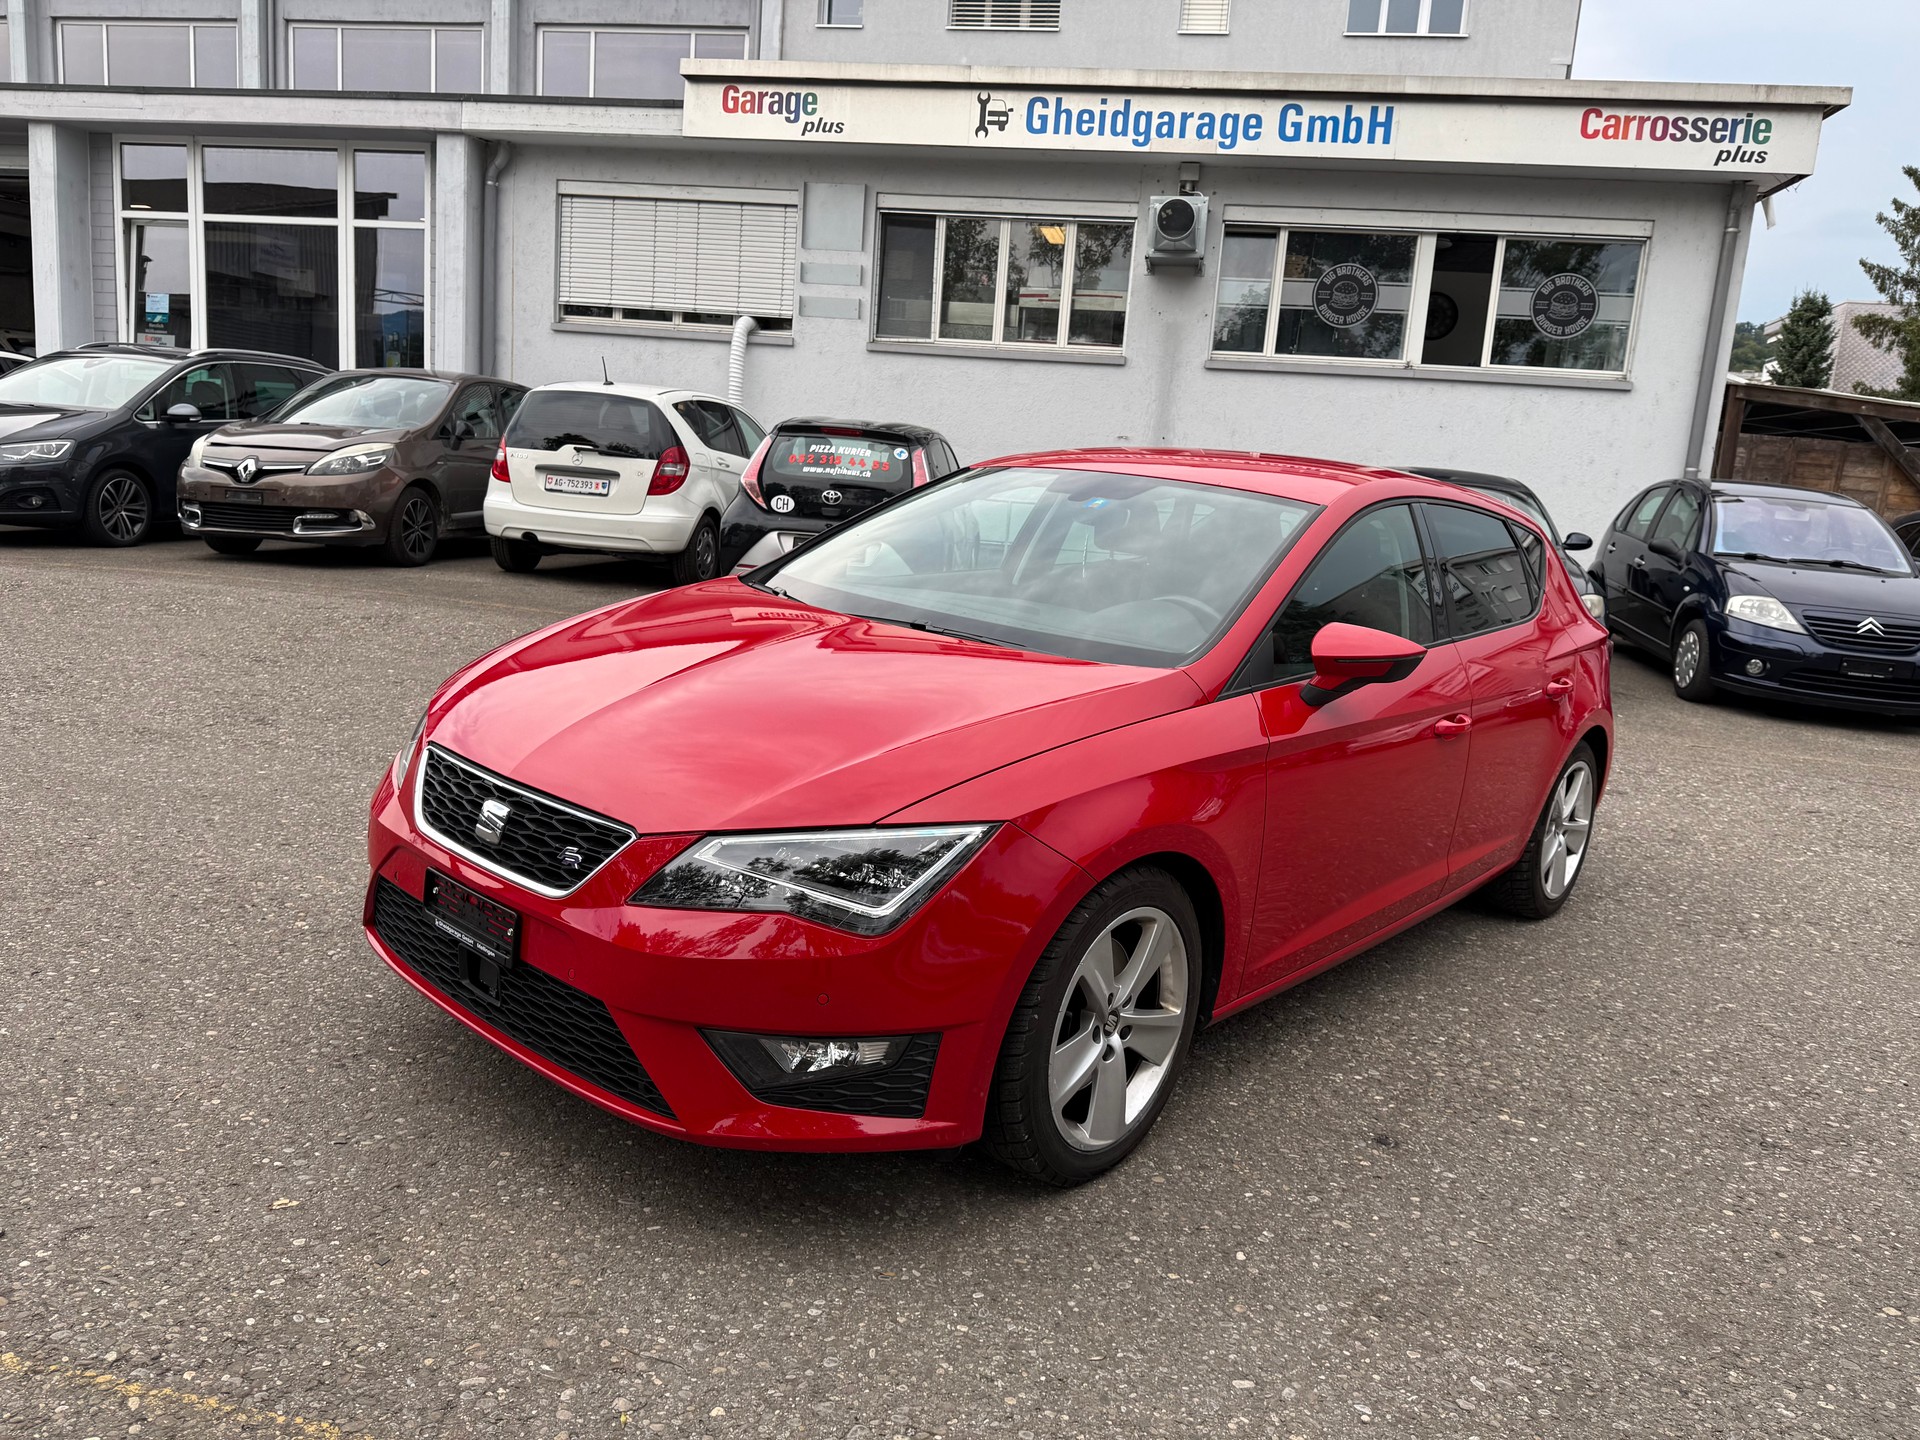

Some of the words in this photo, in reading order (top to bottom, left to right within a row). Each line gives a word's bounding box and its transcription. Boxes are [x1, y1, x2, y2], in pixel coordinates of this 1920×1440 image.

[722, 84, 818, 123] Garage
[801, 117, 845, 136] plus
[1025, 96, 1263, 150] Gheidgarage
[1278, 103, 1395, 145] GmbH
[1580, 107, 1773, 145] Carrosserie
[1713, 145, 1768, 166] plus
[1322, 271, 1337, 285] BIG
[1336, 266, 1372, 286] BROTHERS
[1540, 281, 1555, 295] BIG
[1554, 276, 1593, 296] BROTHERS
[1318, 303, 1344, 324] BURGER
[1346, 305, 1370, 324] HOUSE
[1536, 314, 1563, 335] BURGER
[1564, 315, 1590, 335] HOUSE
[809, 444, 836, 454] PIZZA
[788, 455, 814, 464] 052
[819, 455, 843, 465] 315
[848, 457, 867, 468] 44
[872, 461, 891, 471] 55
[775, 497, 790, 511] CH
